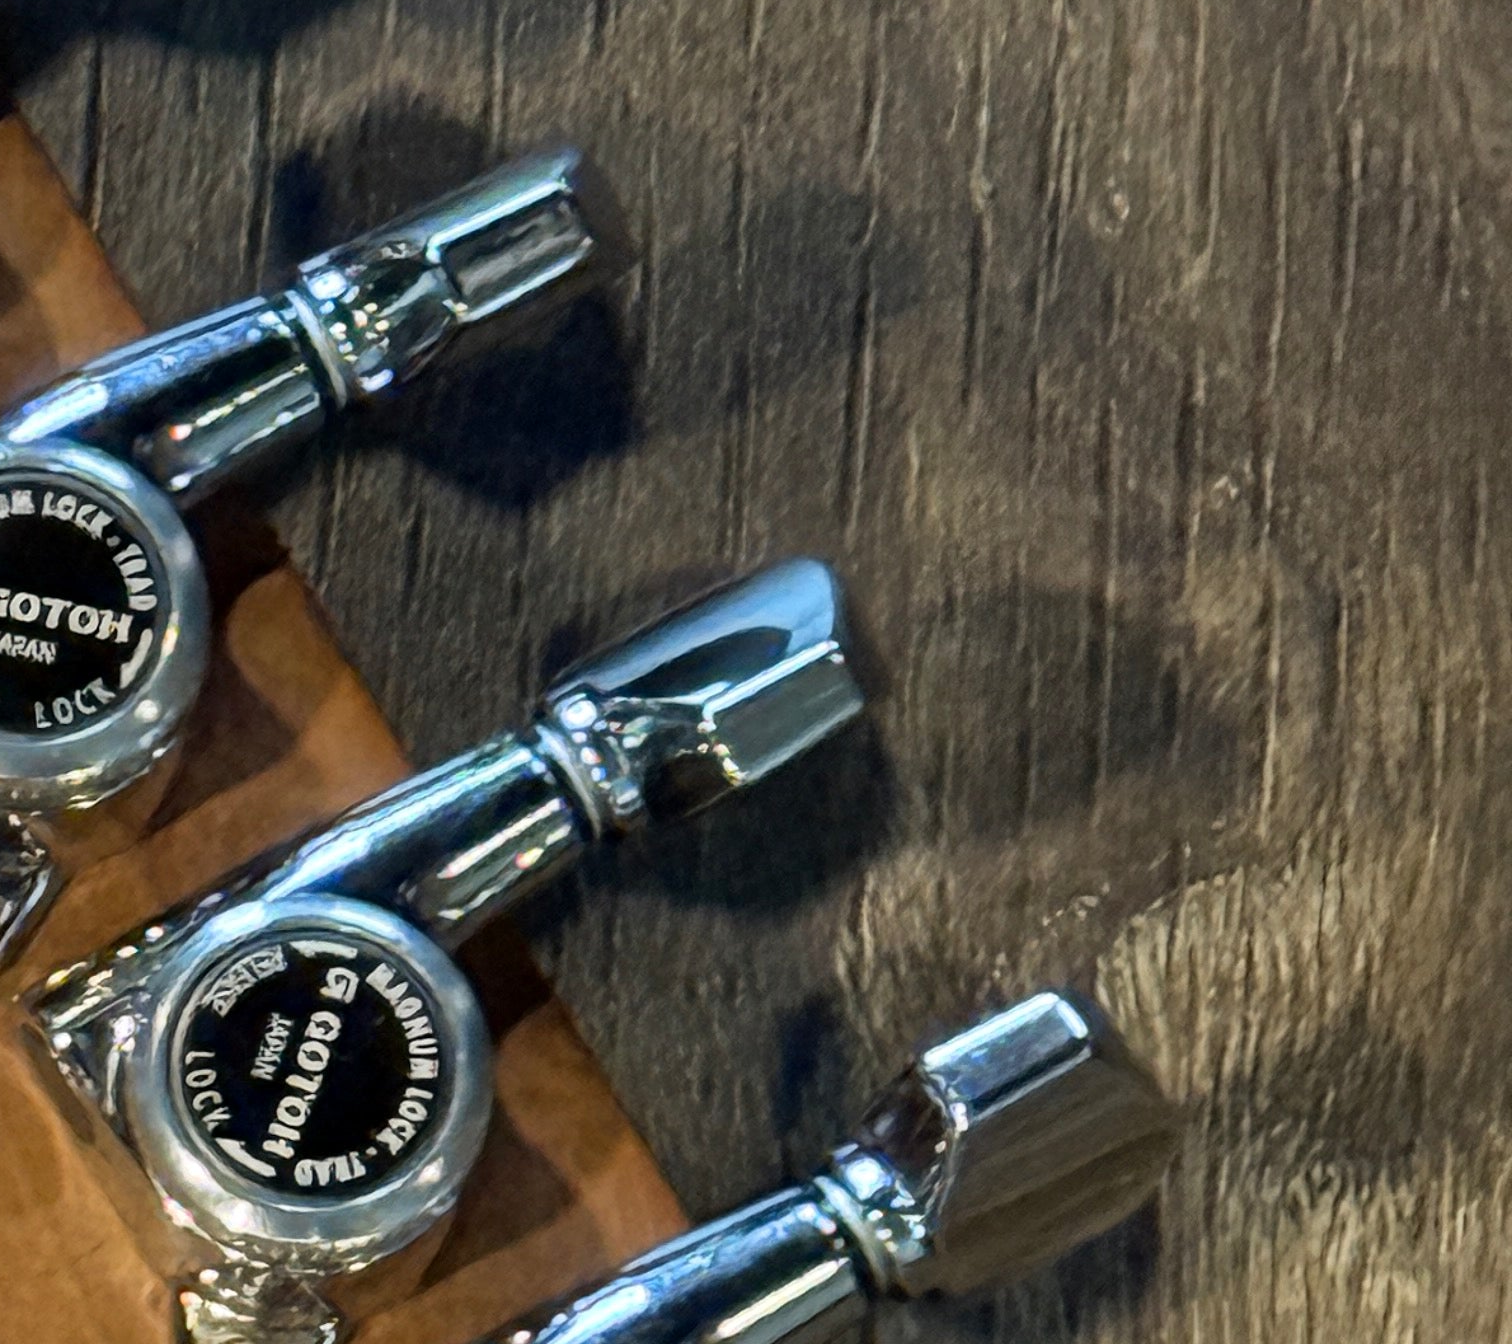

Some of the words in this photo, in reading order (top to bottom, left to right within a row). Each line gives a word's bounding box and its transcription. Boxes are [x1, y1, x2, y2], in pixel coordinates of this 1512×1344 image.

[34, 677, 116, 728] LOCK
[185, 1051, 233, 1132] LOCK
[263, 1010, 342, 1158] GOTOH
